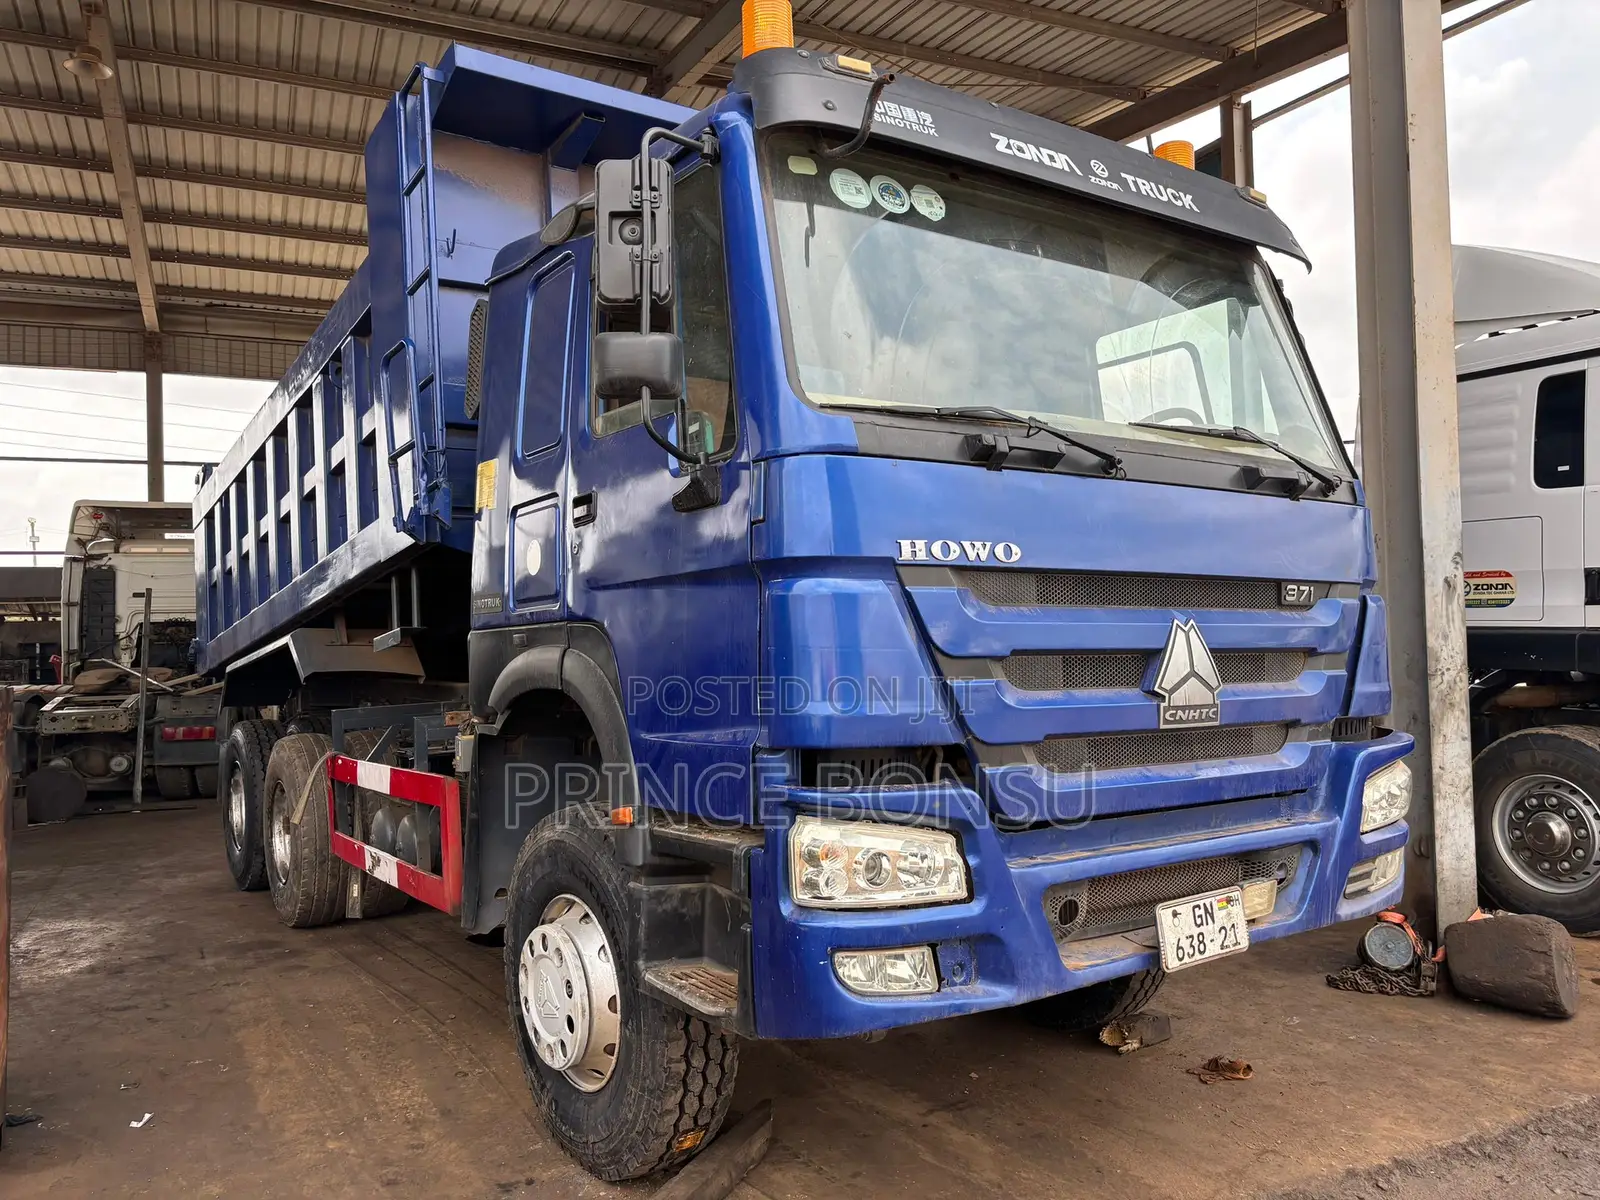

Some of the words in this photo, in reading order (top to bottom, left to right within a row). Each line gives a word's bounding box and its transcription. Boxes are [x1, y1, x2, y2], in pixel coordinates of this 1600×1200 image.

[873, 113, 939, 137] SINOTRUK
[989, 132, 1083, 177] ZONDA
[1120, 172, 1200, 213] TRUCK
[896, 539, 1022, 563] HOWO
[1285, 584, 1314, 602] 371
[1165, 708, 1217, 721] CNHTC
[1192, 901, 1215, 928] GN
